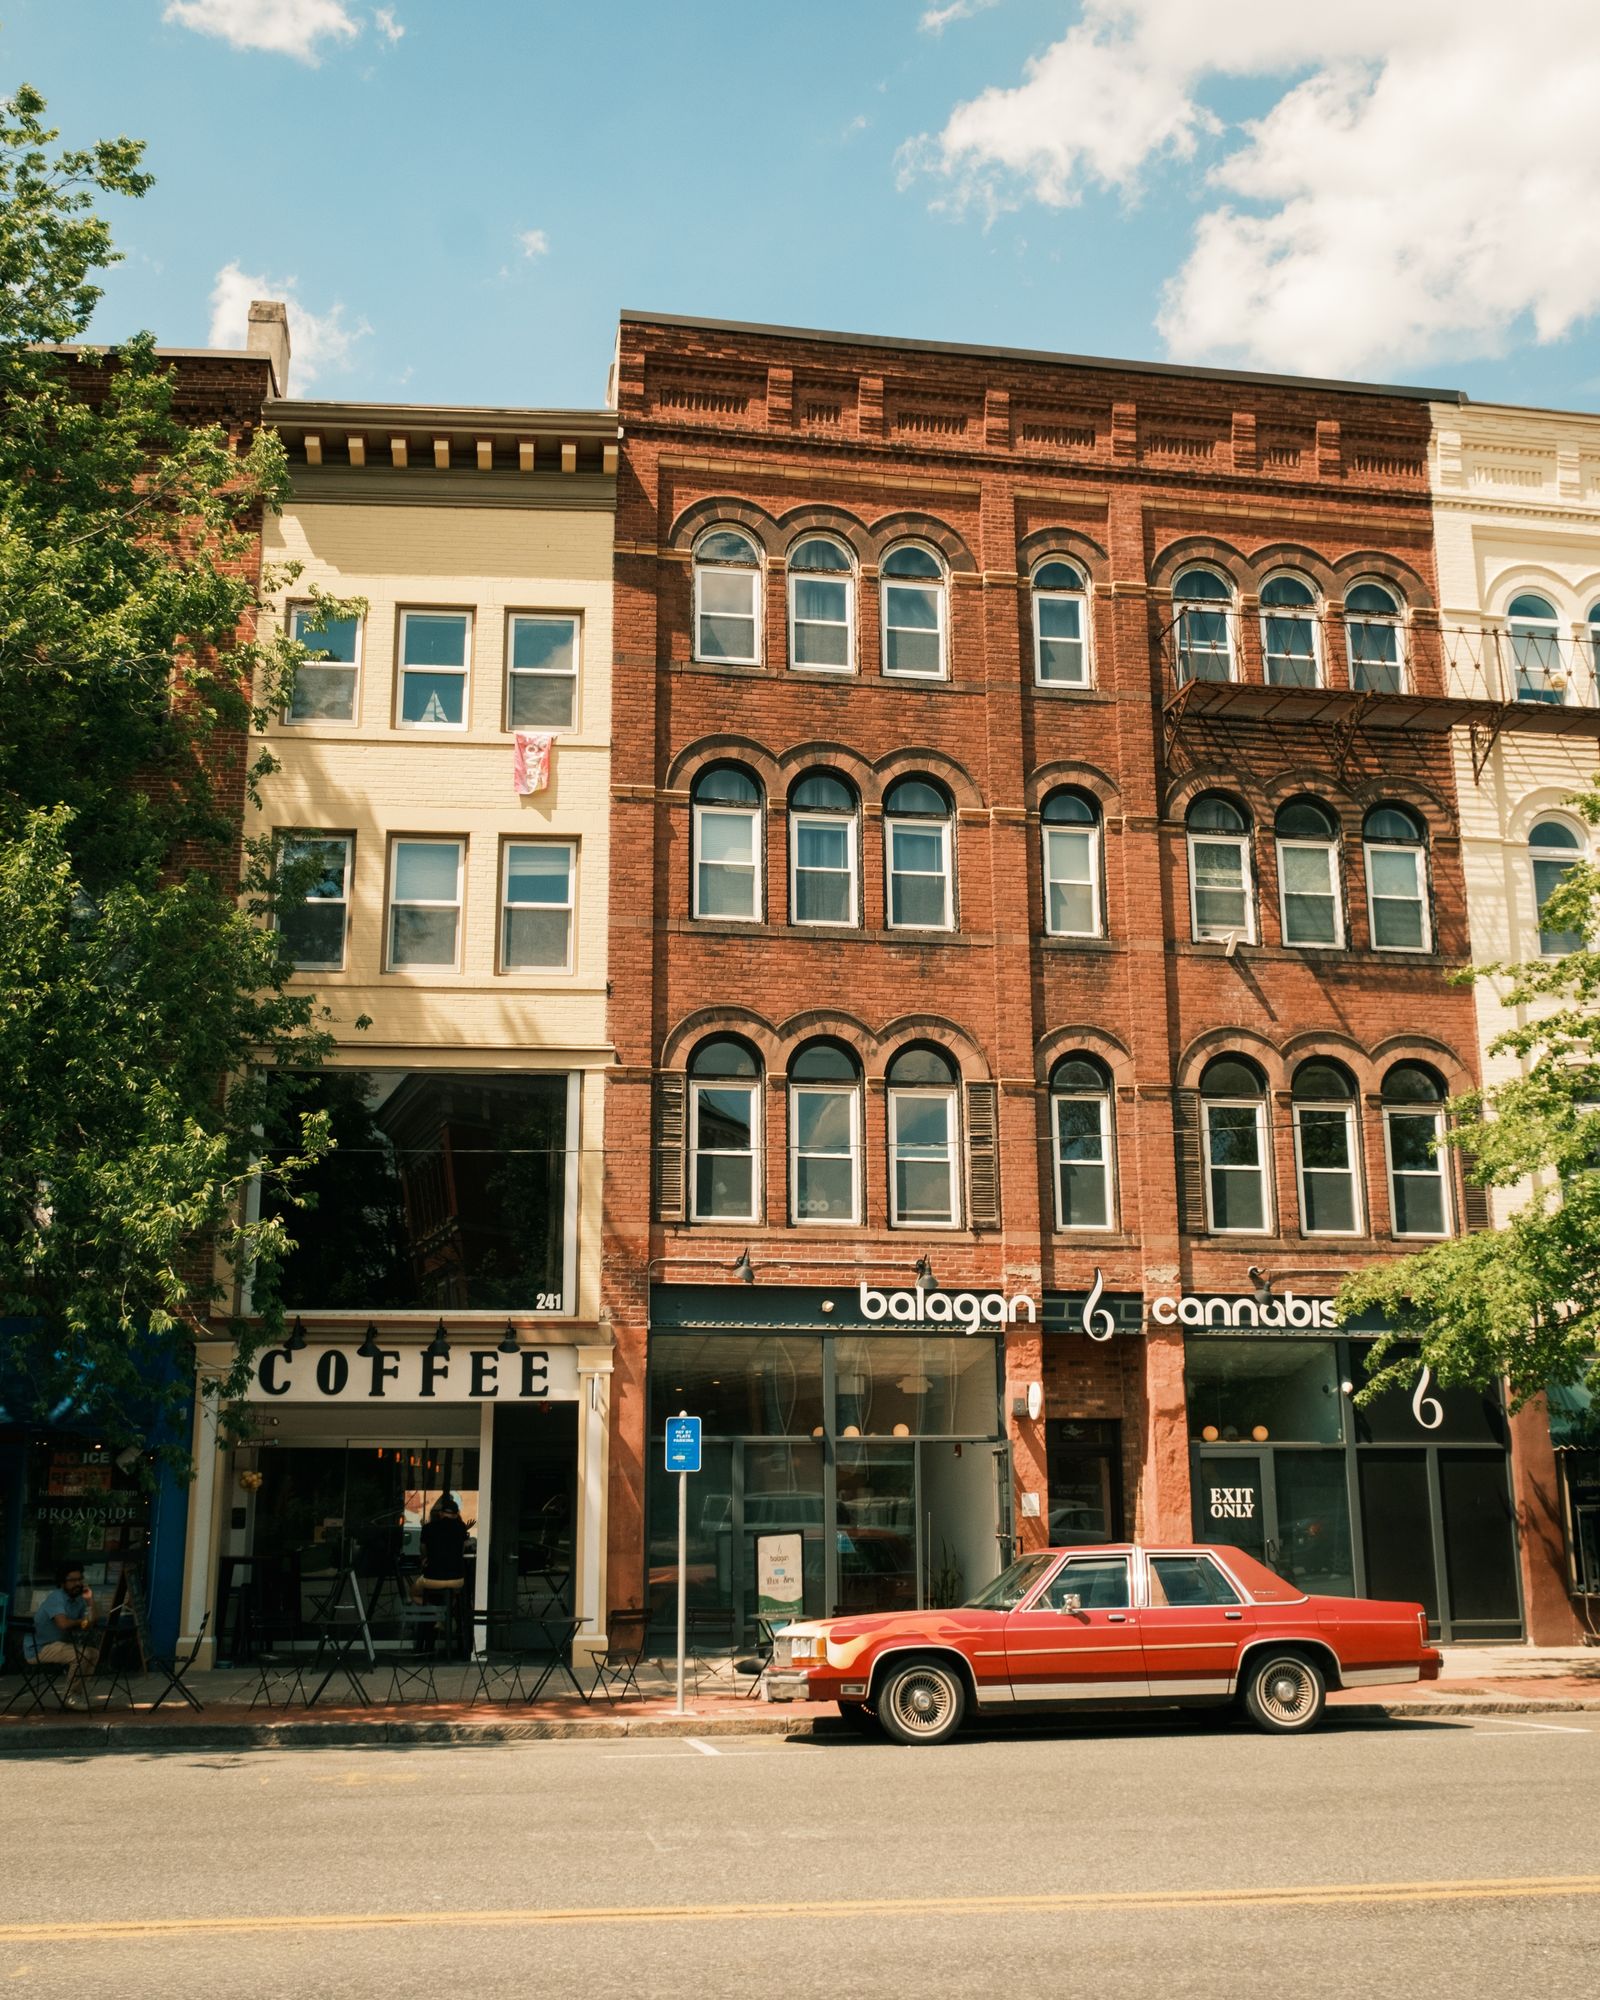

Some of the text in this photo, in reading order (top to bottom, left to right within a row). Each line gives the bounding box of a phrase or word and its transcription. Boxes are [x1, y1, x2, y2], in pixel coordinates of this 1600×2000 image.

[536, 1293, 562, 1309] 241
[860, 1282, 1338, 1335] balagan cannabis
[258, 1350, 549, 1397] COFFEE
[83, 1452, 110, 1464] ICE
[1210, 1488, 1254, 1503] EXIT
[38, 1507, 137, 1520] BROADSIDE
[1210, 1503, 1255, 1518] ONLY
